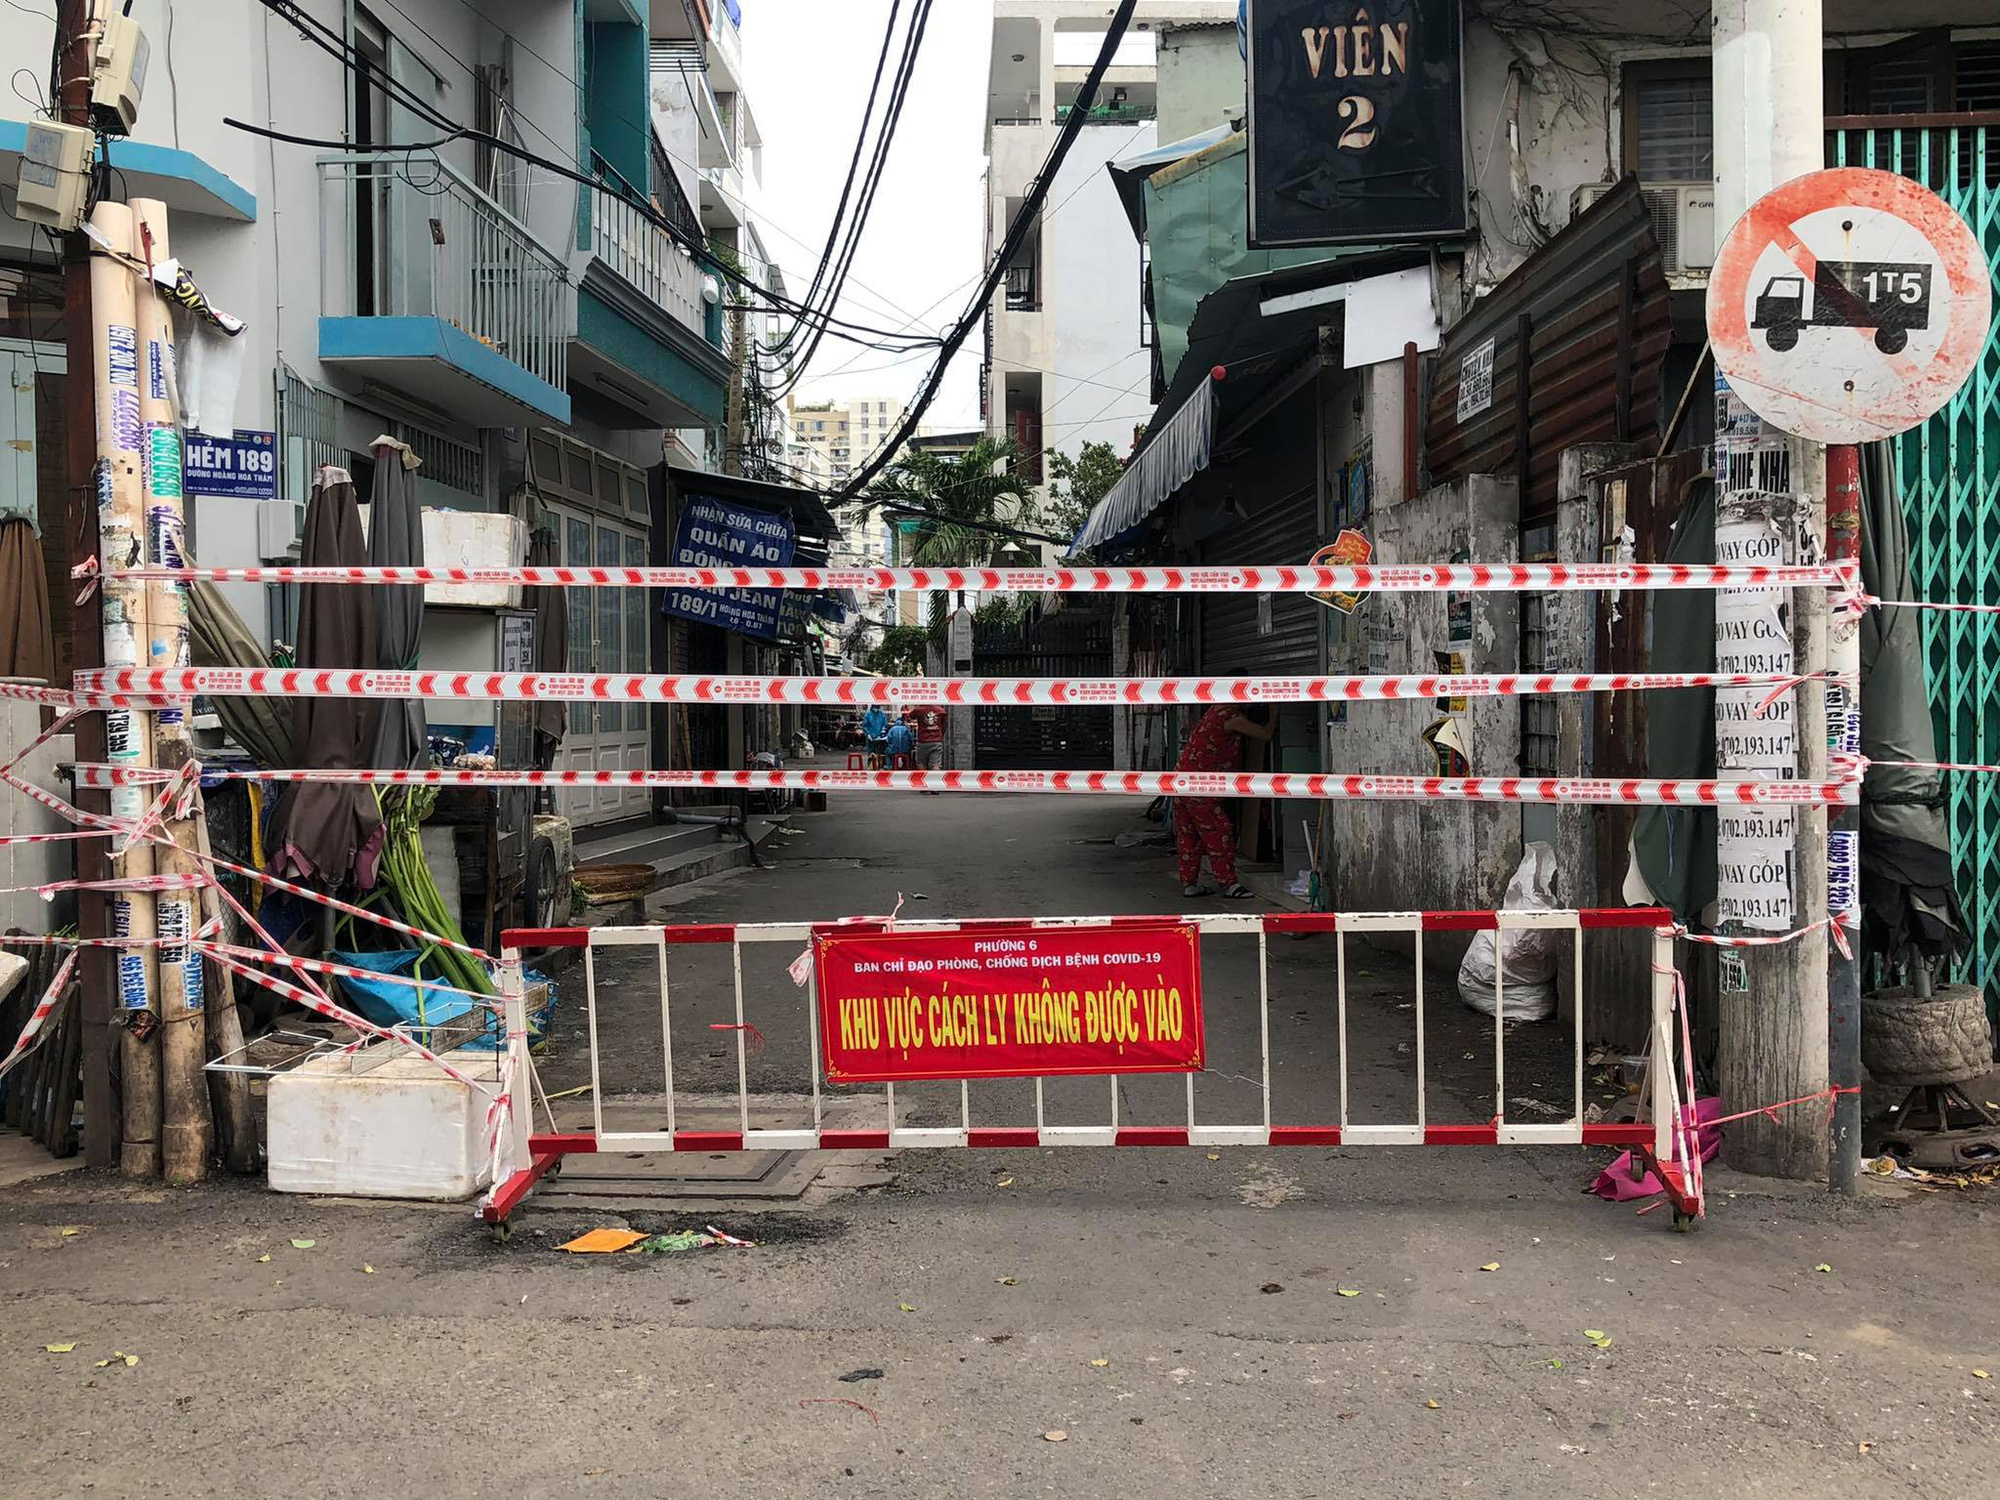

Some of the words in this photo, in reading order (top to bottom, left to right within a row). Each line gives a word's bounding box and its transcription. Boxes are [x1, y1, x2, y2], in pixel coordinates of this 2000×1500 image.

[1301, 7, 1409, 79] VIÊN
[1337, 95, 1376, 150] 2
[1862, 271, 1922, 304] 1T5
[187, 440, 231, 470] HẺM
[237, 449, 273, 473] 189
[1758, 438, 1790, 493] NHÀ
[238, 473, 252, 481] HOA
[691, 505, 725, 525] NHẬN
[690, 526, 745, 554] QUẦN
[750, 540, 780, 562] ÁO
[1720, 540, 1742, 560] VAY
[1745, 532, 1780, 559] GÓP
[671, 592, 718, 619] 189/1
[1727, 621, 1750, 640] VAY
[1726, 702, 1750, 721] VAY
[1722, 736, 1790, 756] 0702.193.147
[1722, 818, 1790, 838] 0702.193.147
[1723, 865, 1746, 883] VAY
[1749, 859, 1784, 884] GÓP
[973, 940, 1026, 953] PHƯỜNG
[1028, 940, 1038, 951] 6
[853, 961, 880, 973] BAN
[883, 956, 904, 972] CHỈ
[907, 959, 934, 975] ĐẠO
[936, 954, 982, 972] PHÒNG,
[985, 953, 1029, 969] CHỐNG
[1031, 954, 1062, 970] DỊCH
[1065, 951, 1100, 968] BỆNH
[1103, 952, 1161, 966] COVID-19
[838, 996, 879, 1051] KHU
[883, 985, 923, 1061] VỰC
[928, 979, 980, 1048] CÁCH
[983, 992, 1009, 1046] LY
[1014, 977, 1081, 1045] KHÔNG
[1085, 980, 1139, 1055] ĐƯỢC
[1142, 974, 1183, 1043] VÀO
